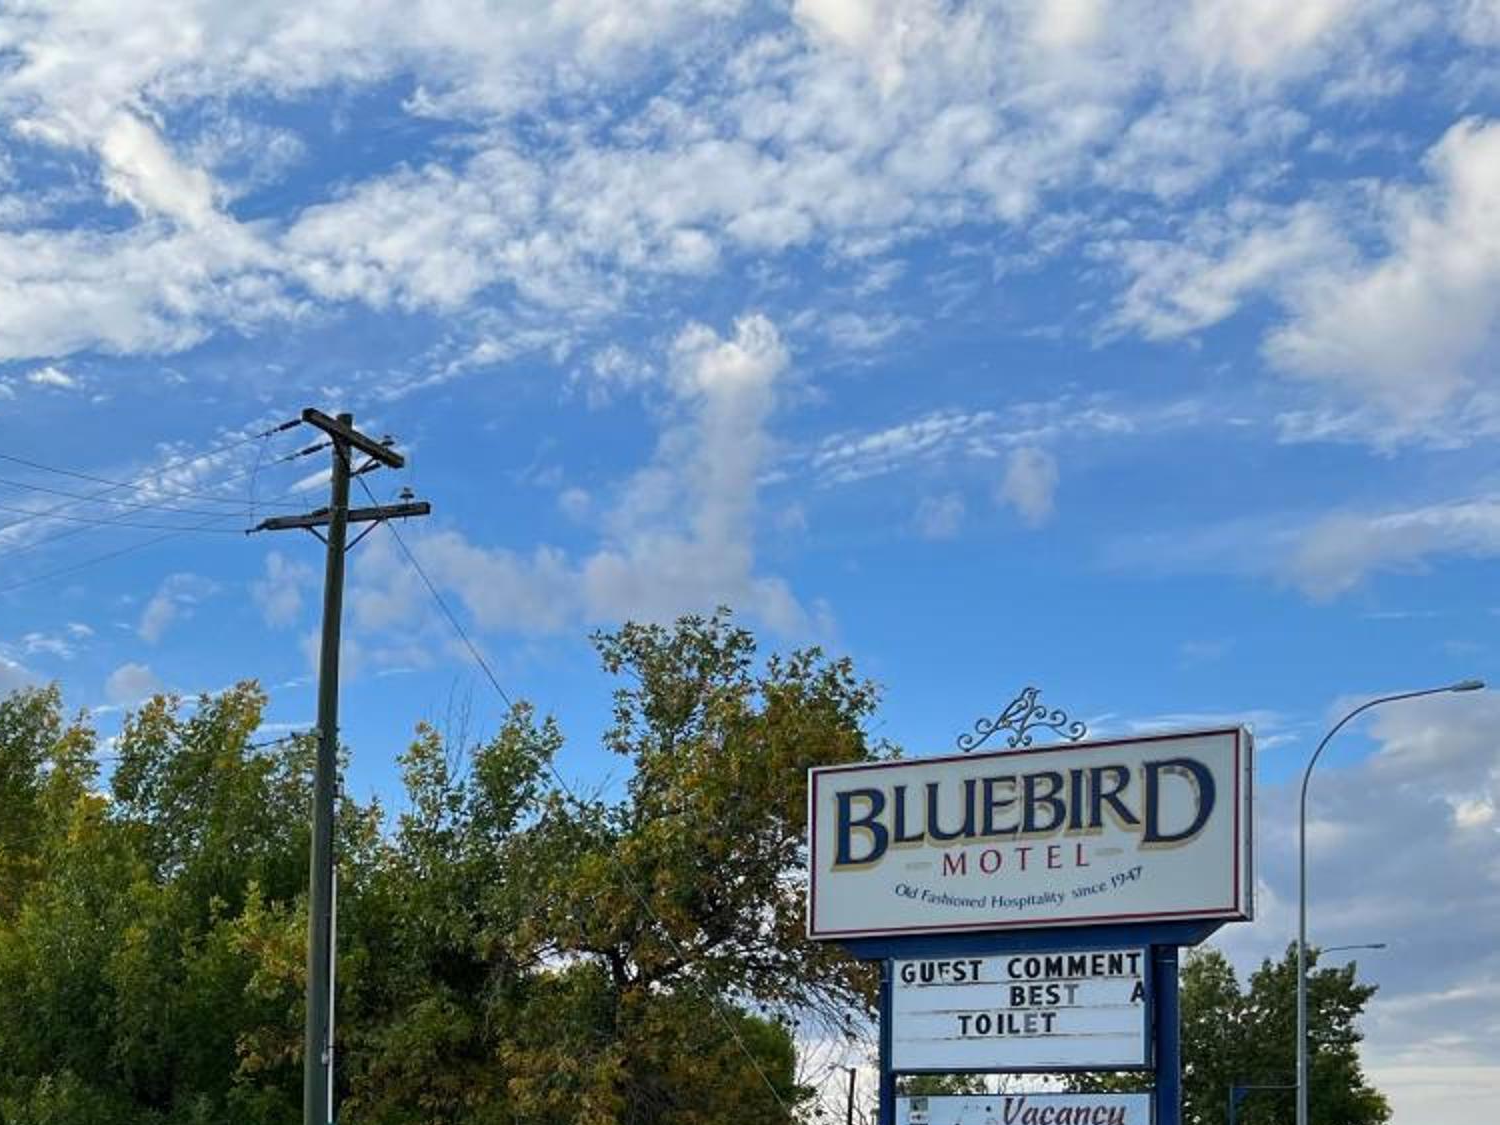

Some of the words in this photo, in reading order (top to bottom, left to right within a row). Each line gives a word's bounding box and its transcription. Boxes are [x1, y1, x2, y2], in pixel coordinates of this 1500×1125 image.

[832, 757, 1216, 871] BLUEBIRD
[942, 843, 1090, 876] MOTEL
[894, 882, 919, 899] Old
[921, 889, 987, 909] Fashioned
[991, 891, 1064, 910] Hospitality
[1071, 882, 1107, 899] since
[1110, 865, 1143, 889] 1947
[1007, 952, 1141, 978] COMMENT
[1010, 984, 1080, 1007] BEST
[1130, 981, 1145, 1002] A
[957, 1012, 1057, 1036] TOILET
